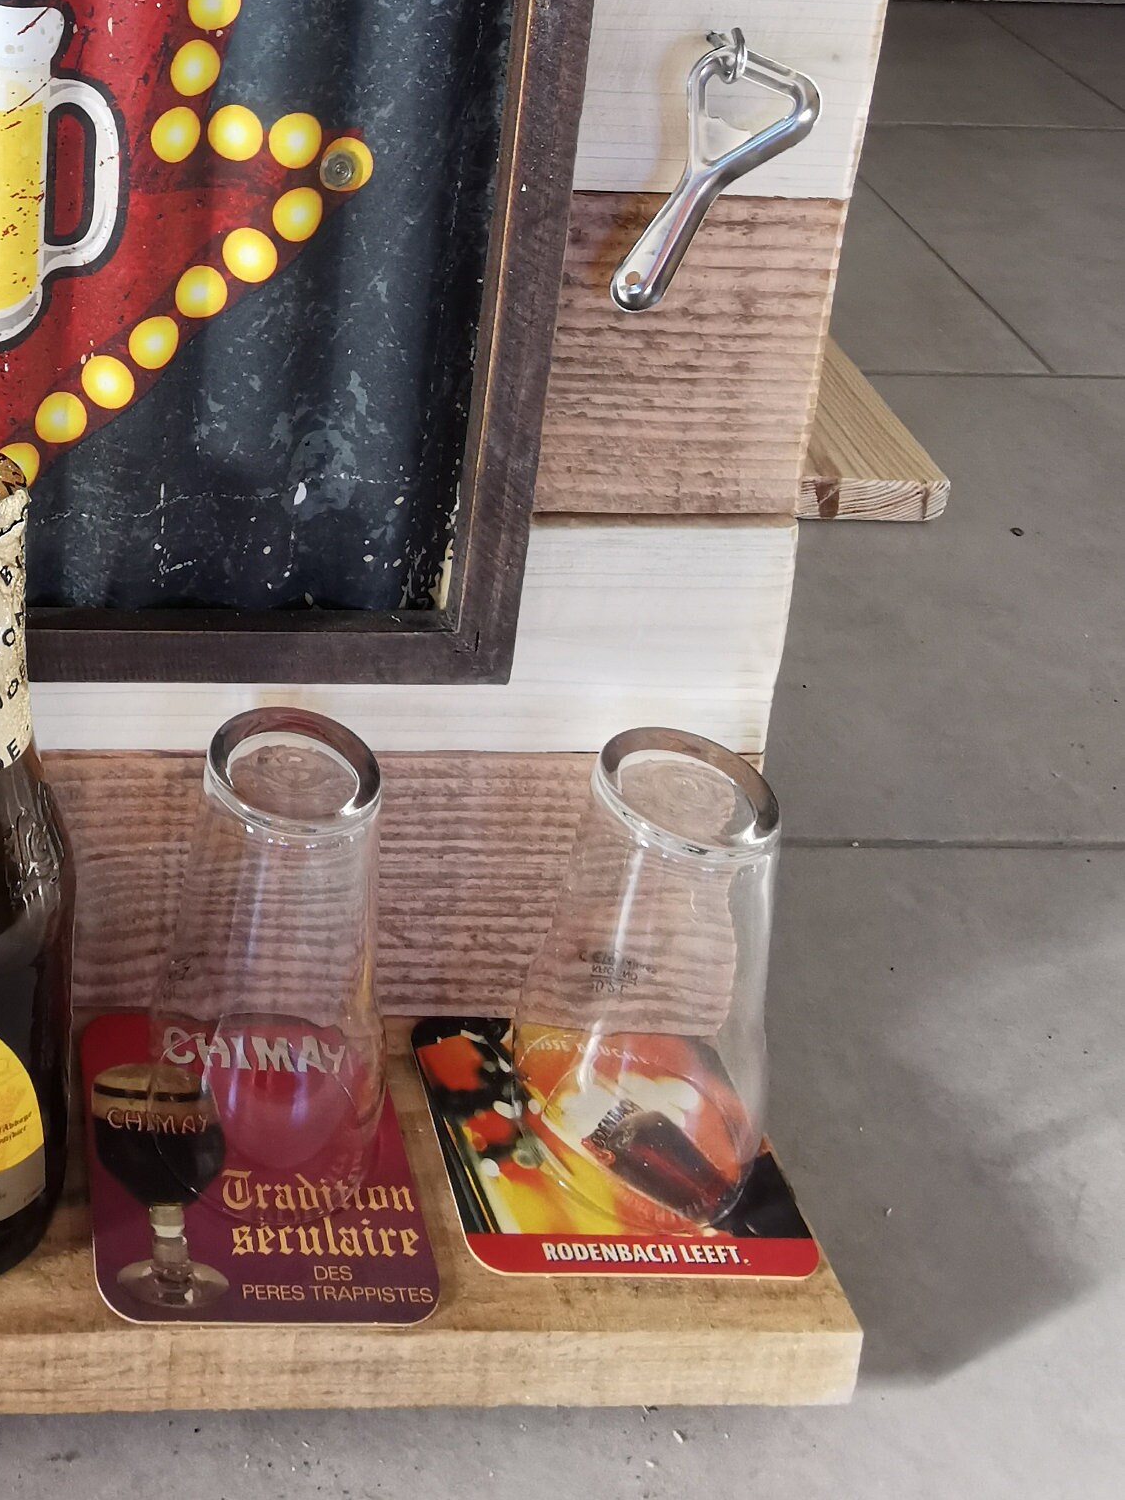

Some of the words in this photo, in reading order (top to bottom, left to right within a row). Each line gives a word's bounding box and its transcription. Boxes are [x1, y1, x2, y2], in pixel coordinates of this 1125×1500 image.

[163, 1025, 347, 1074] CHIMAY
[106, 1107, 209, 1135] CHIMAY
[222, 1168, 415, 1212] Tradition
[231, 1216, 420, 1258] séculaire
[541, 1241, 678, 1263] RODENBACH
[678, 1244, 752, 1266] LEEFT.
[313, 1265, 354, 1281] DES
[242, 1283, 305, 1300] PERES
[309, 1285, 434, 1304] TRAPPISTES
